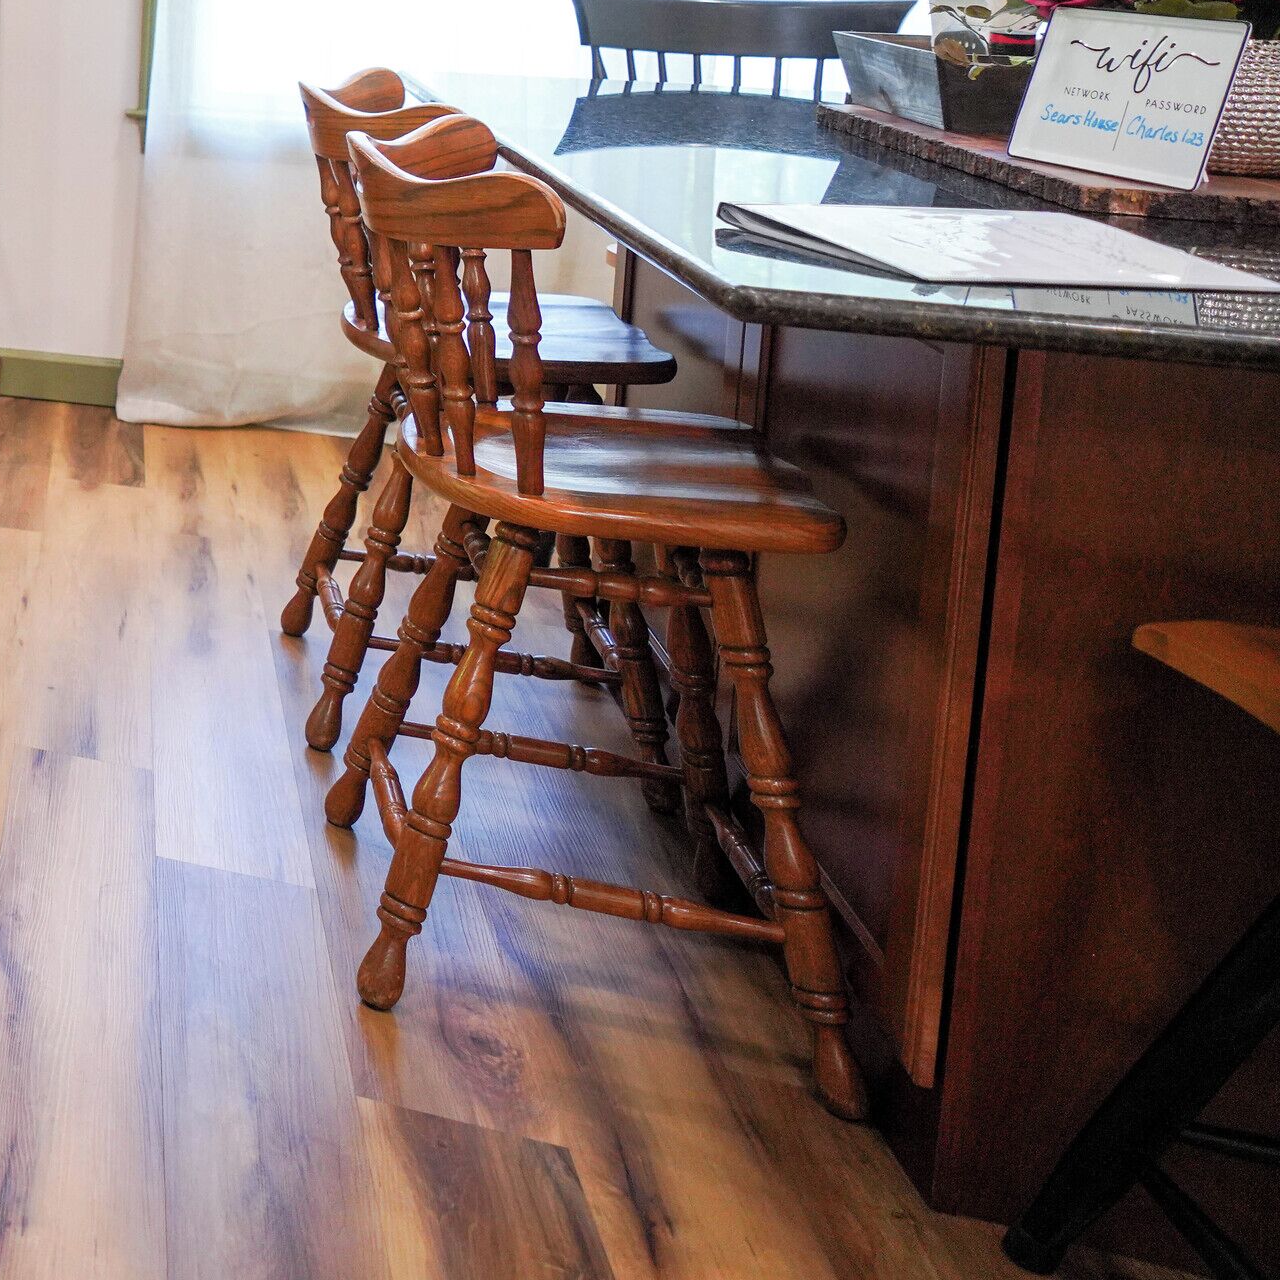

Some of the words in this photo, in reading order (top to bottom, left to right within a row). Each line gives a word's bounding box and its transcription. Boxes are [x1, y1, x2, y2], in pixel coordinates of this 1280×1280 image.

[1070, 35, 1222, 94] wifi
[1063, 86, 1111, 102] NETWORK
[1145, 98, 1208, 116] PASSWORD
[1040, 103, 1081, 126] Sears
[1083, 109, 1118, 132] House
